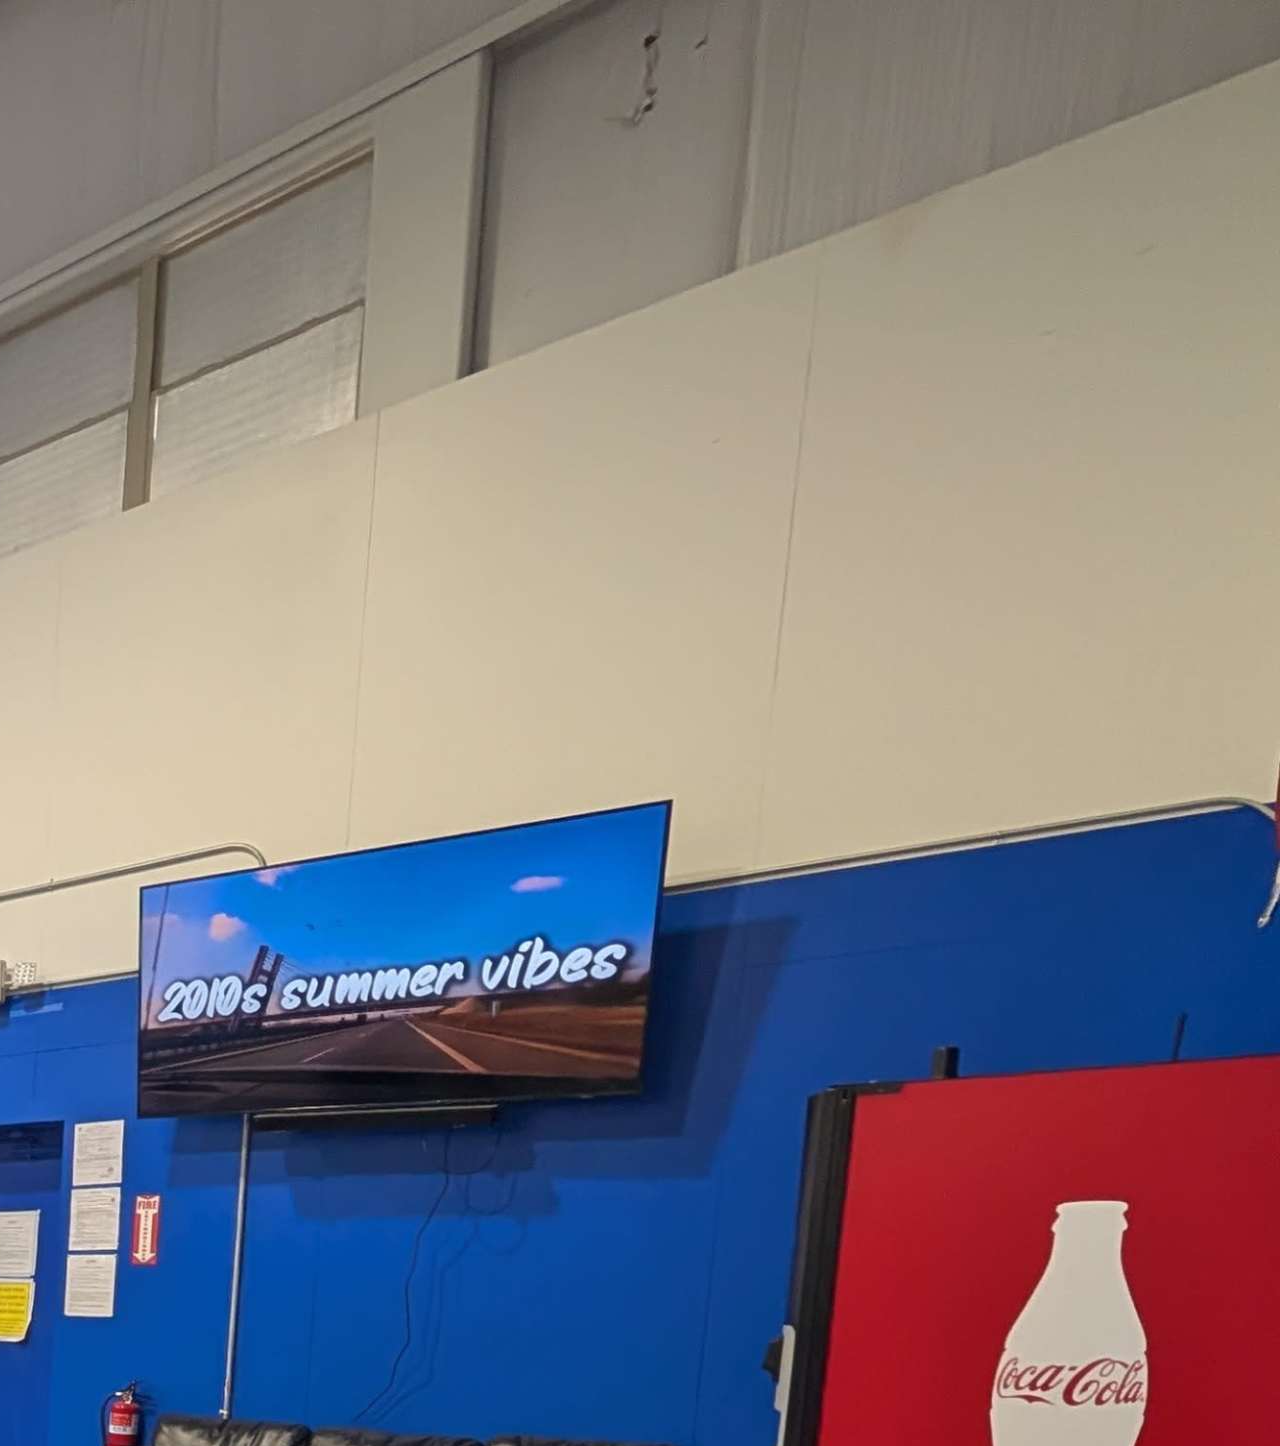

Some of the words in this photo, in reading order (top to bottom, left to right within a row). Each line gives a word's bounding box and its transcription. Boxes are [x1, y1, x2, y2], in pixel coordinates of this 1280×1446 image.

[157, 975, 268, 1022] 2010s
[279, 959, 465, 1011] summer
[481, 937, 627, 991] vibes
[138, 1199, 158, 1210] FIRE
[996, 1357, 1144, 1406] Coca-Cola
